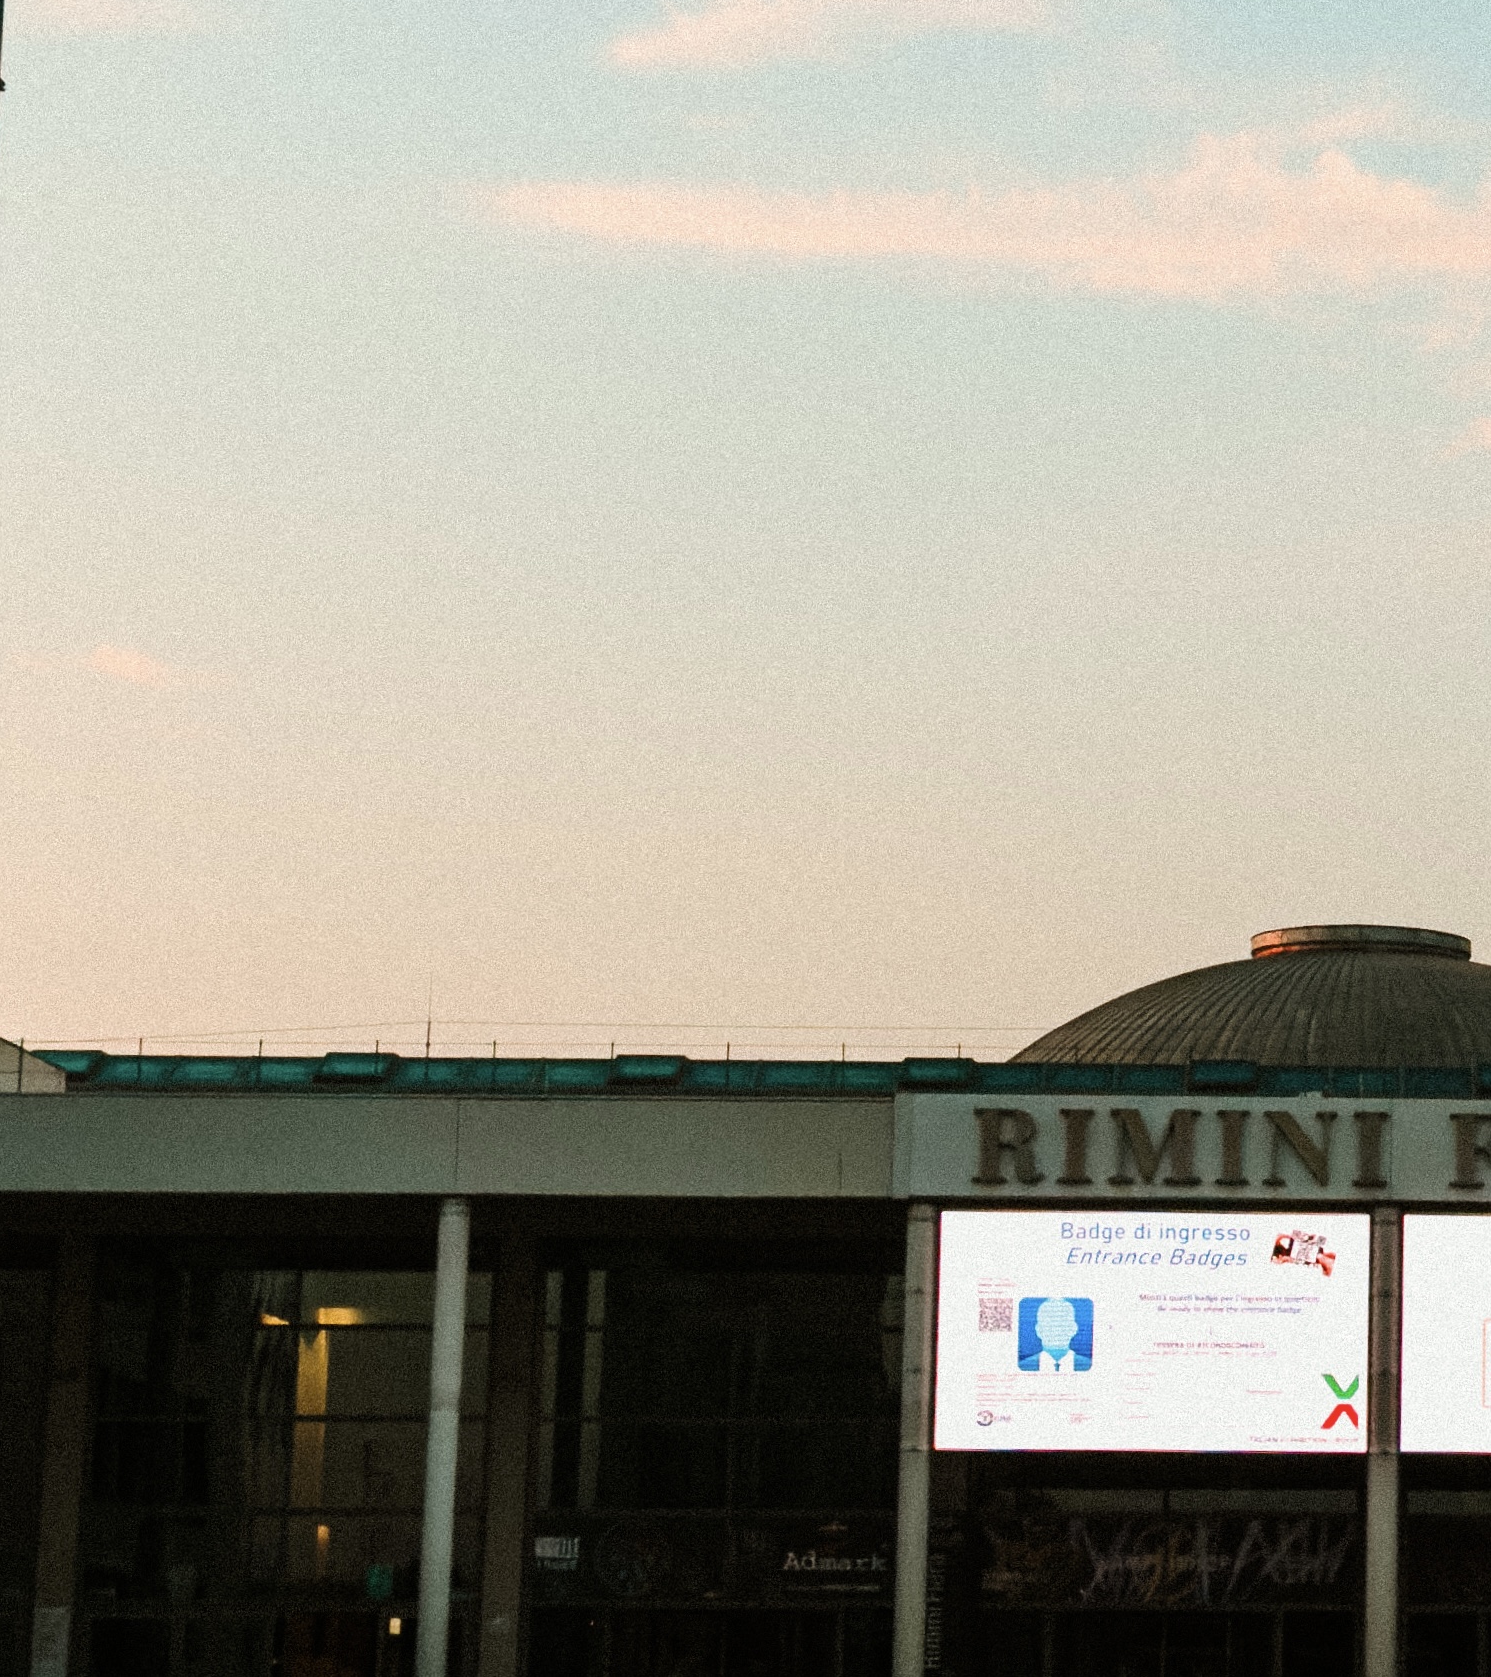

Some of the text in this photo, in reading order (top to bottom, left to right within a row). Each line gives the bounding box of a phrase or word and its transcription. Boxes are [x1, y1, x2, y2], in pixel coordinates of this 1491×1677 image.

[971, 1107, 1391, 1189] RIMINI
[1061, 1222, 1251, 1245] Badge di ingresso
[1065, 1247, 1248, 1270] Entrance Badges
[782, 1549, 888, 1571] Admark
